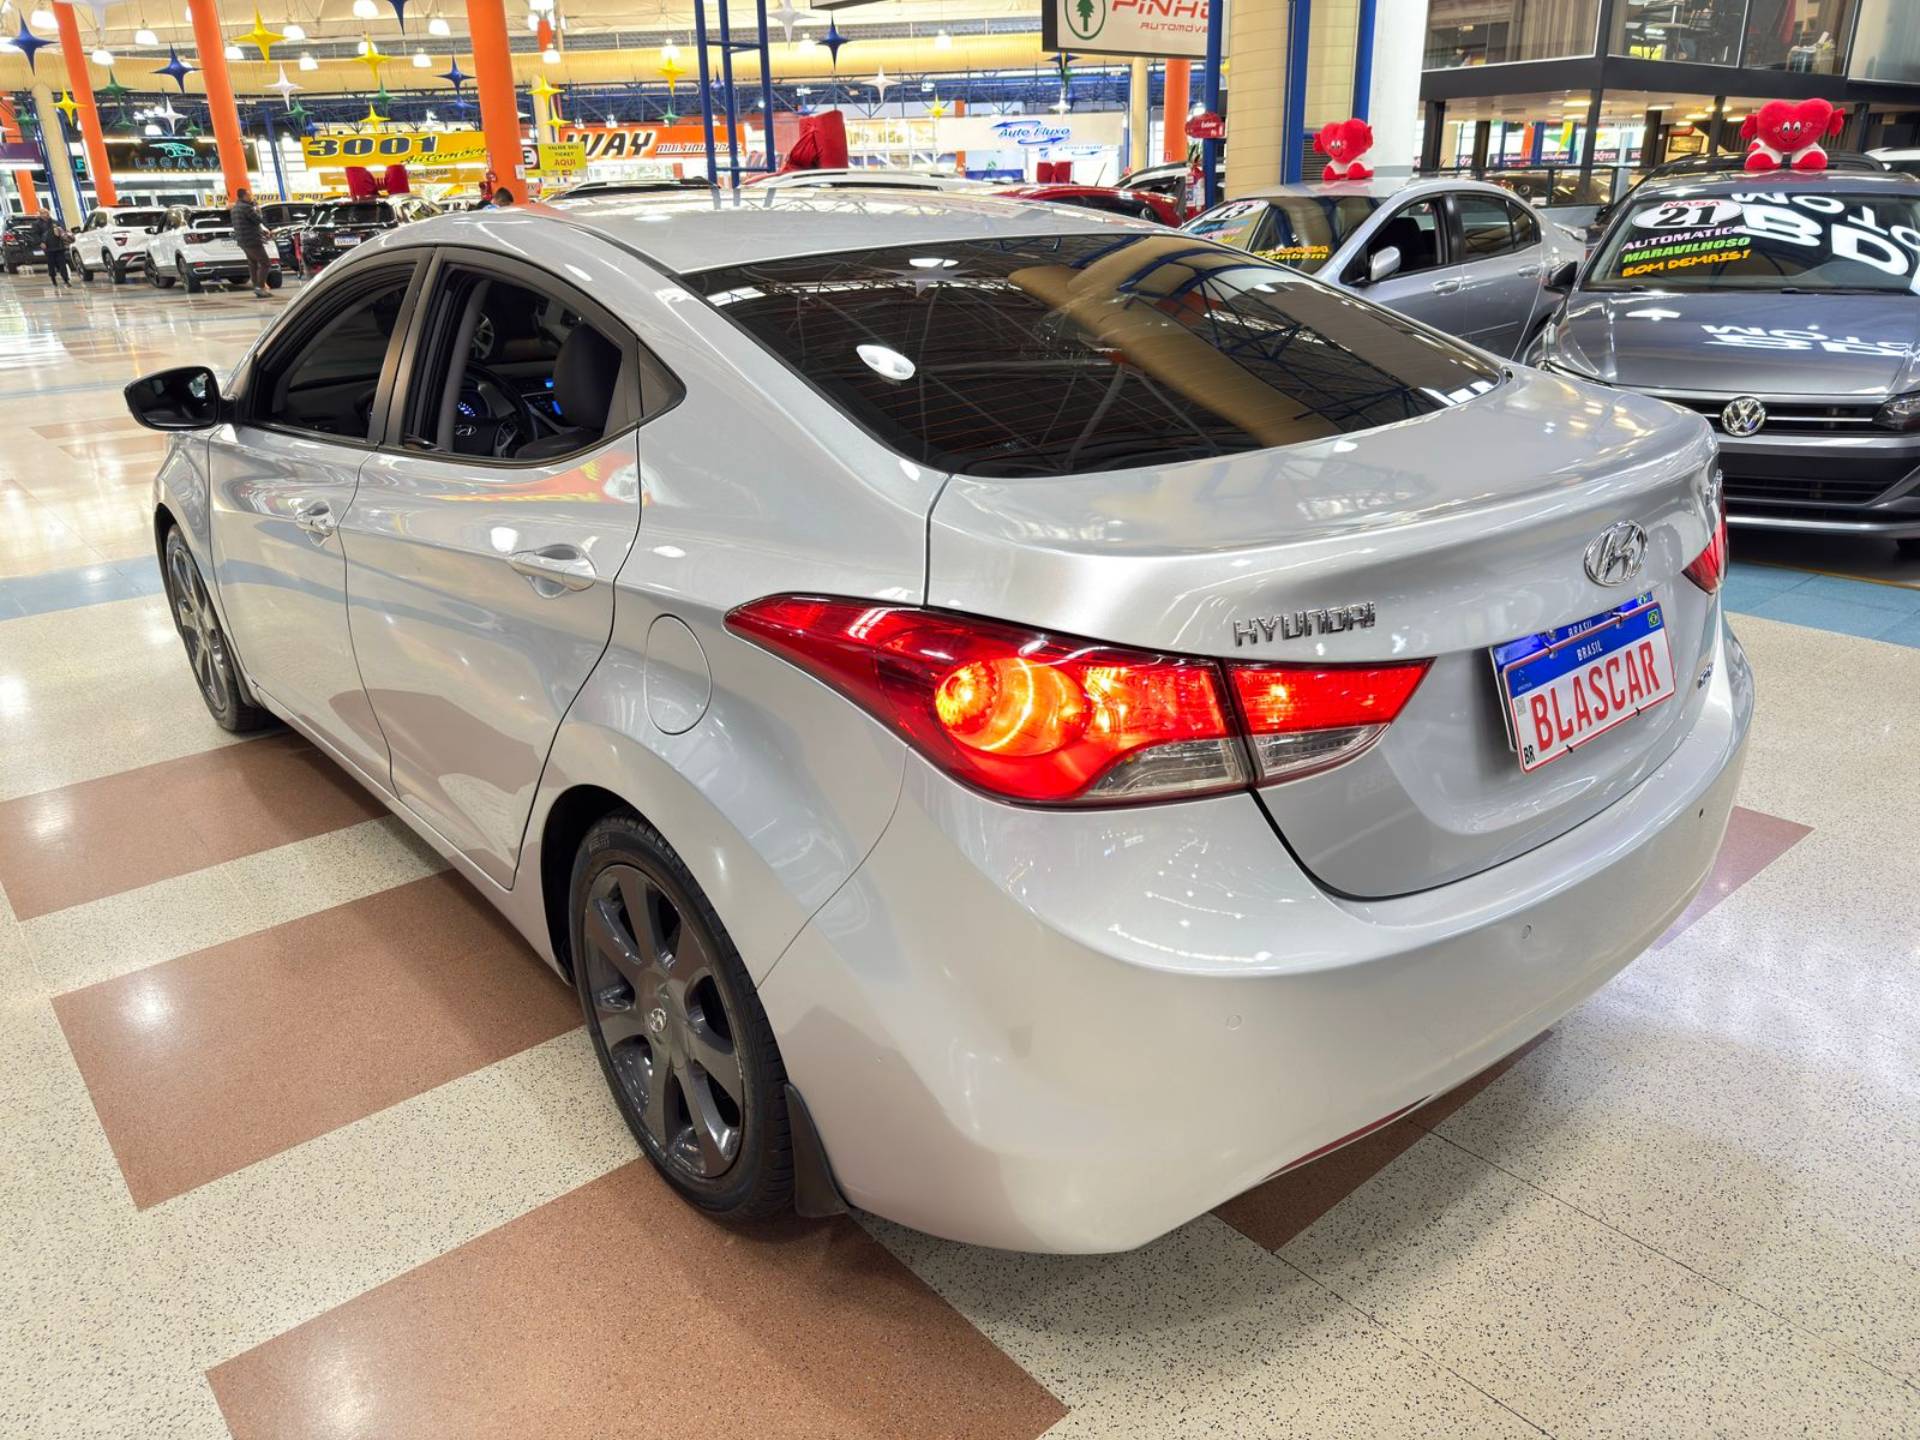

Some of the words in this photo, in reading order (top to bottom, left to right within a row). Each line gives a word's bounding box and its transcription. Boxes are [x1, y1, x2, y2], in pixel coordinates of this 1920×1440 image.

[306, 135, 439, 158] 3001
[134, 156, 219, 169] LEGACY
[1653, 206, 1716, 228] 21
[1622, 236, 1752, 264] MARAVILHOSO
[1621, 261, 1665, 278] BOM
[1233, 601, 1377, 648] HYUNDAI
[1576, 639, 1604, 662] BRASIL
[1530, 640, 1662, 752] BLASCAR
[1523, 744, 1537, 765] BR
